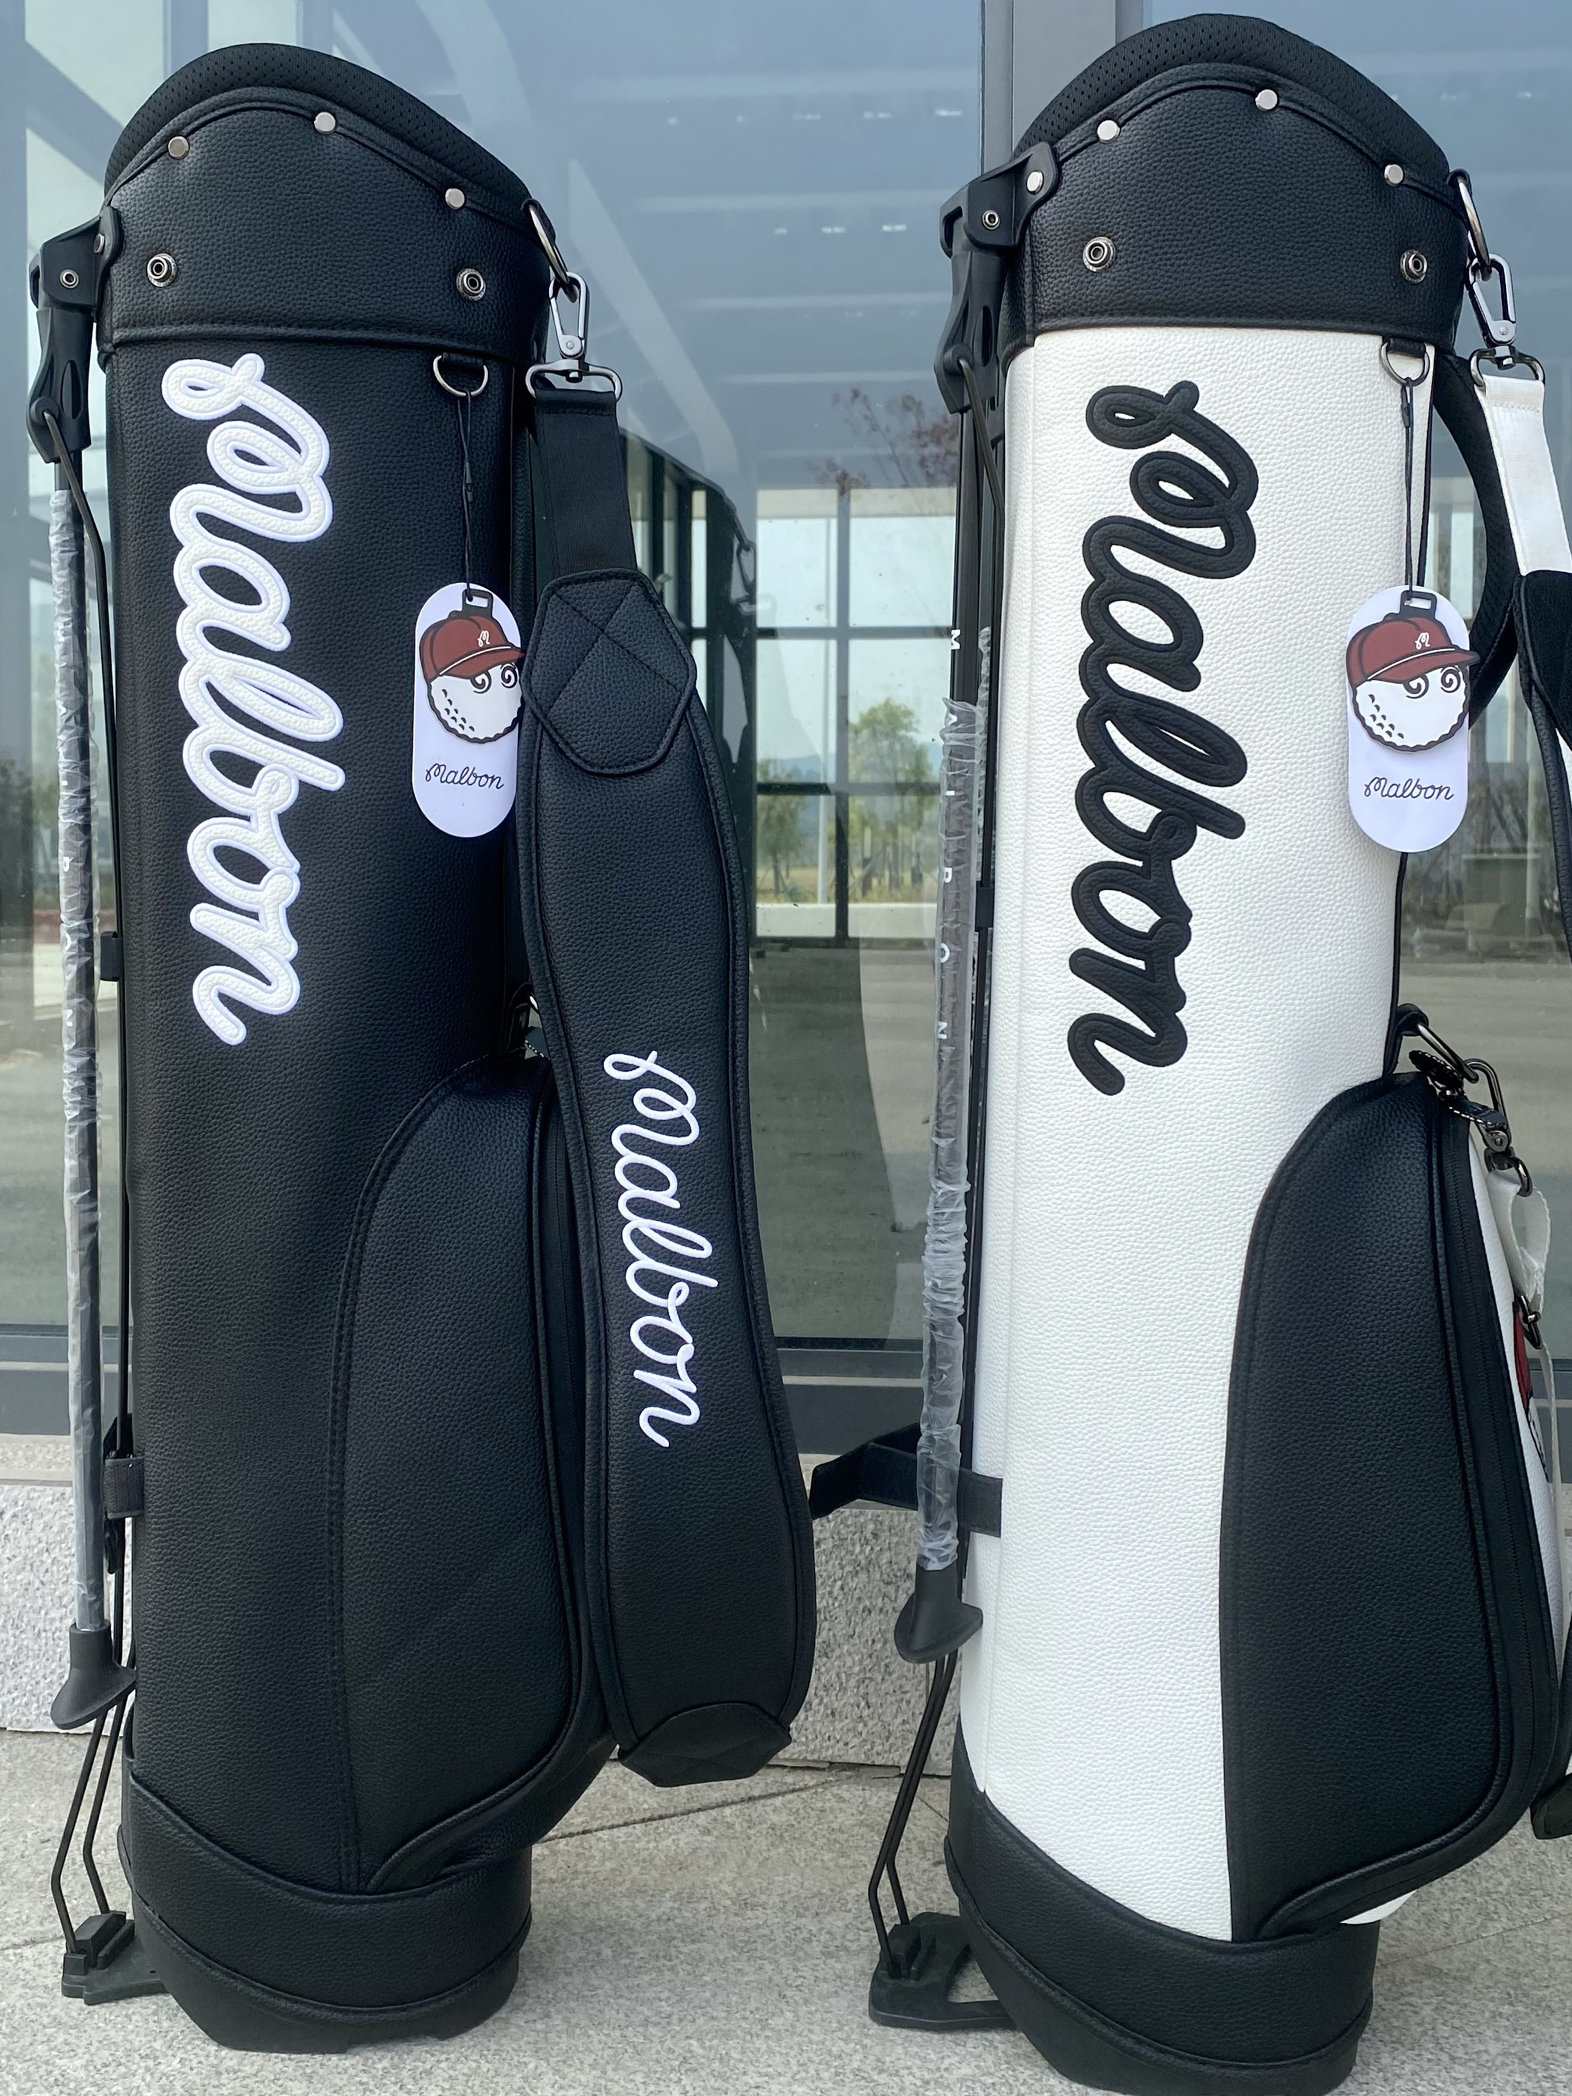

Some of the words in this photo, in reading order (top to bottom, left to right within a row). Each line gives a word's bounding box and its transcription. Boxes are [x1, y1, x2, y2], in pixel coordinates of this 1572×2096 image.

[161, 353, 346, 1046] Malbon
[425, 762, 504, 790] Malbon
[1066, 379, 1260, 1096] Malbon
[1364, 776, 1455, 801] Malbon
[603, 1050, 719, 1448] Malbon
